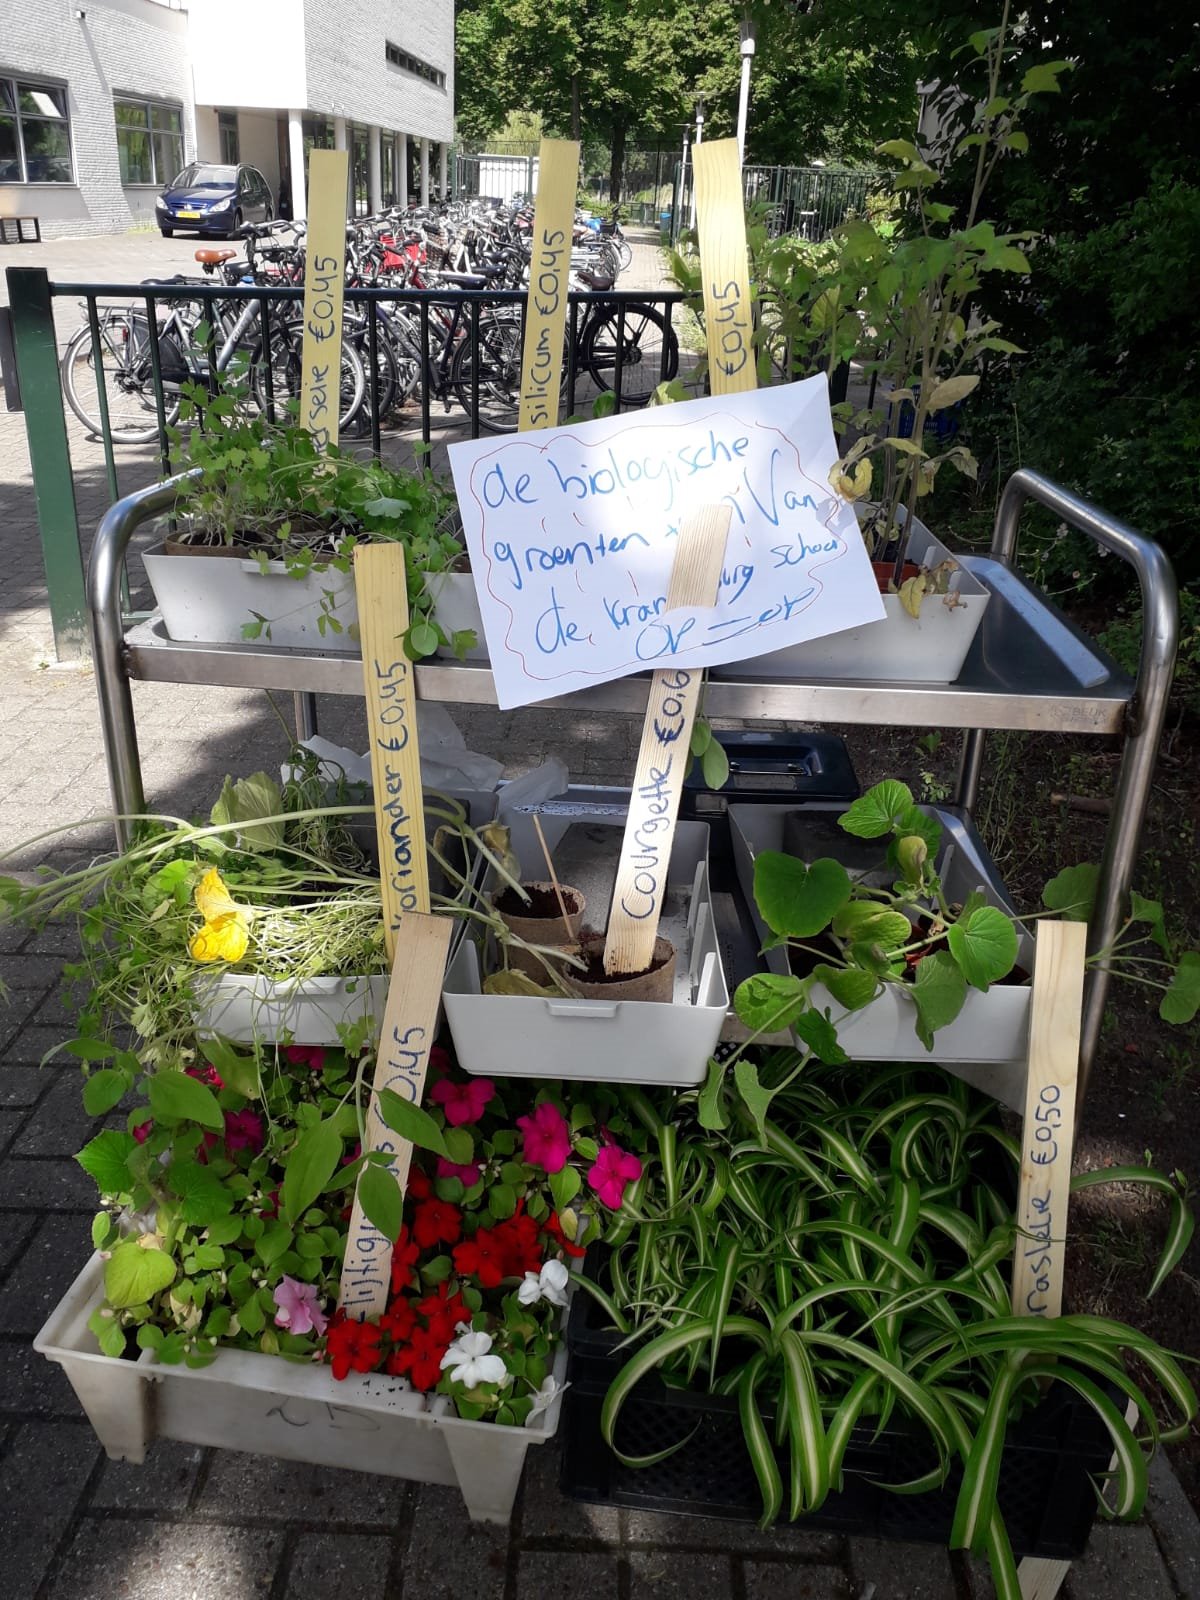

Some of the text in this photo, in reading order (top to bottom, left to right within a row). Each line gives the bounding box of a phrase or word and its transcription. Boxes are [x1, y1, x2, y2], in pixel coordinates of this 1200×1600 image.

[308, 255, 338, 343] €0,45
[524, 229, 565, 429] silicum €0,45
[712, 280, 748, 376] €0,45
[483, 430, 749, 512] de biologische
[493, 531, 650, 591] groenten
[535, 587, 588, 654] de
[374, 659, 409, 751] €0,45
[654, 669, 691, 746] €0,6
[1024, 1084, 1062, 1316] raslelie €0,50
